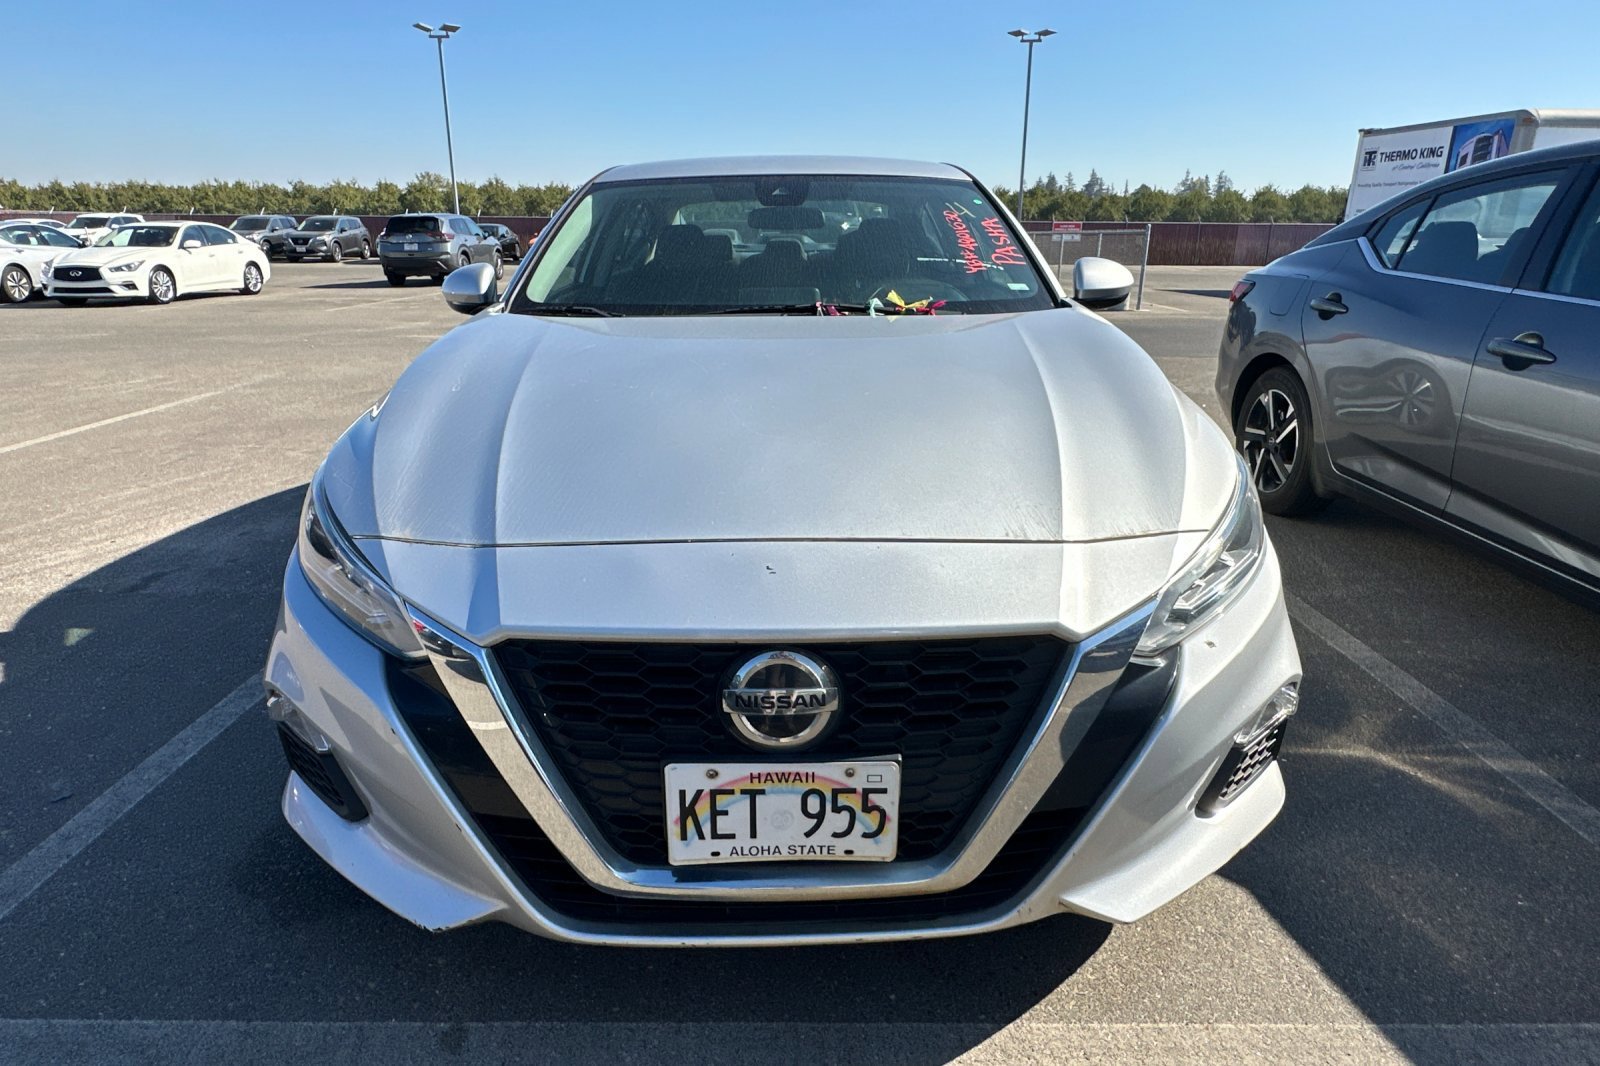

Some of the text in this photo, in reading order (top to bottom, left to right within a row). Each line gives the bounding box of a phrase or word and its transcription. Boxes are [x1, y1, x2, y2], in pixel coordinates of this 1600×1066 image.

[1379, 146, 1444, 163] THERMO KING
[981, 217, 1026, 265] PASHA
[735, 693, 826, 710] NISSAN
[749, 772, 815, 784] HAWAII
[678, 788, 888, 841] KET 955
[729, 844, 836, 857] ALOHA STATE
